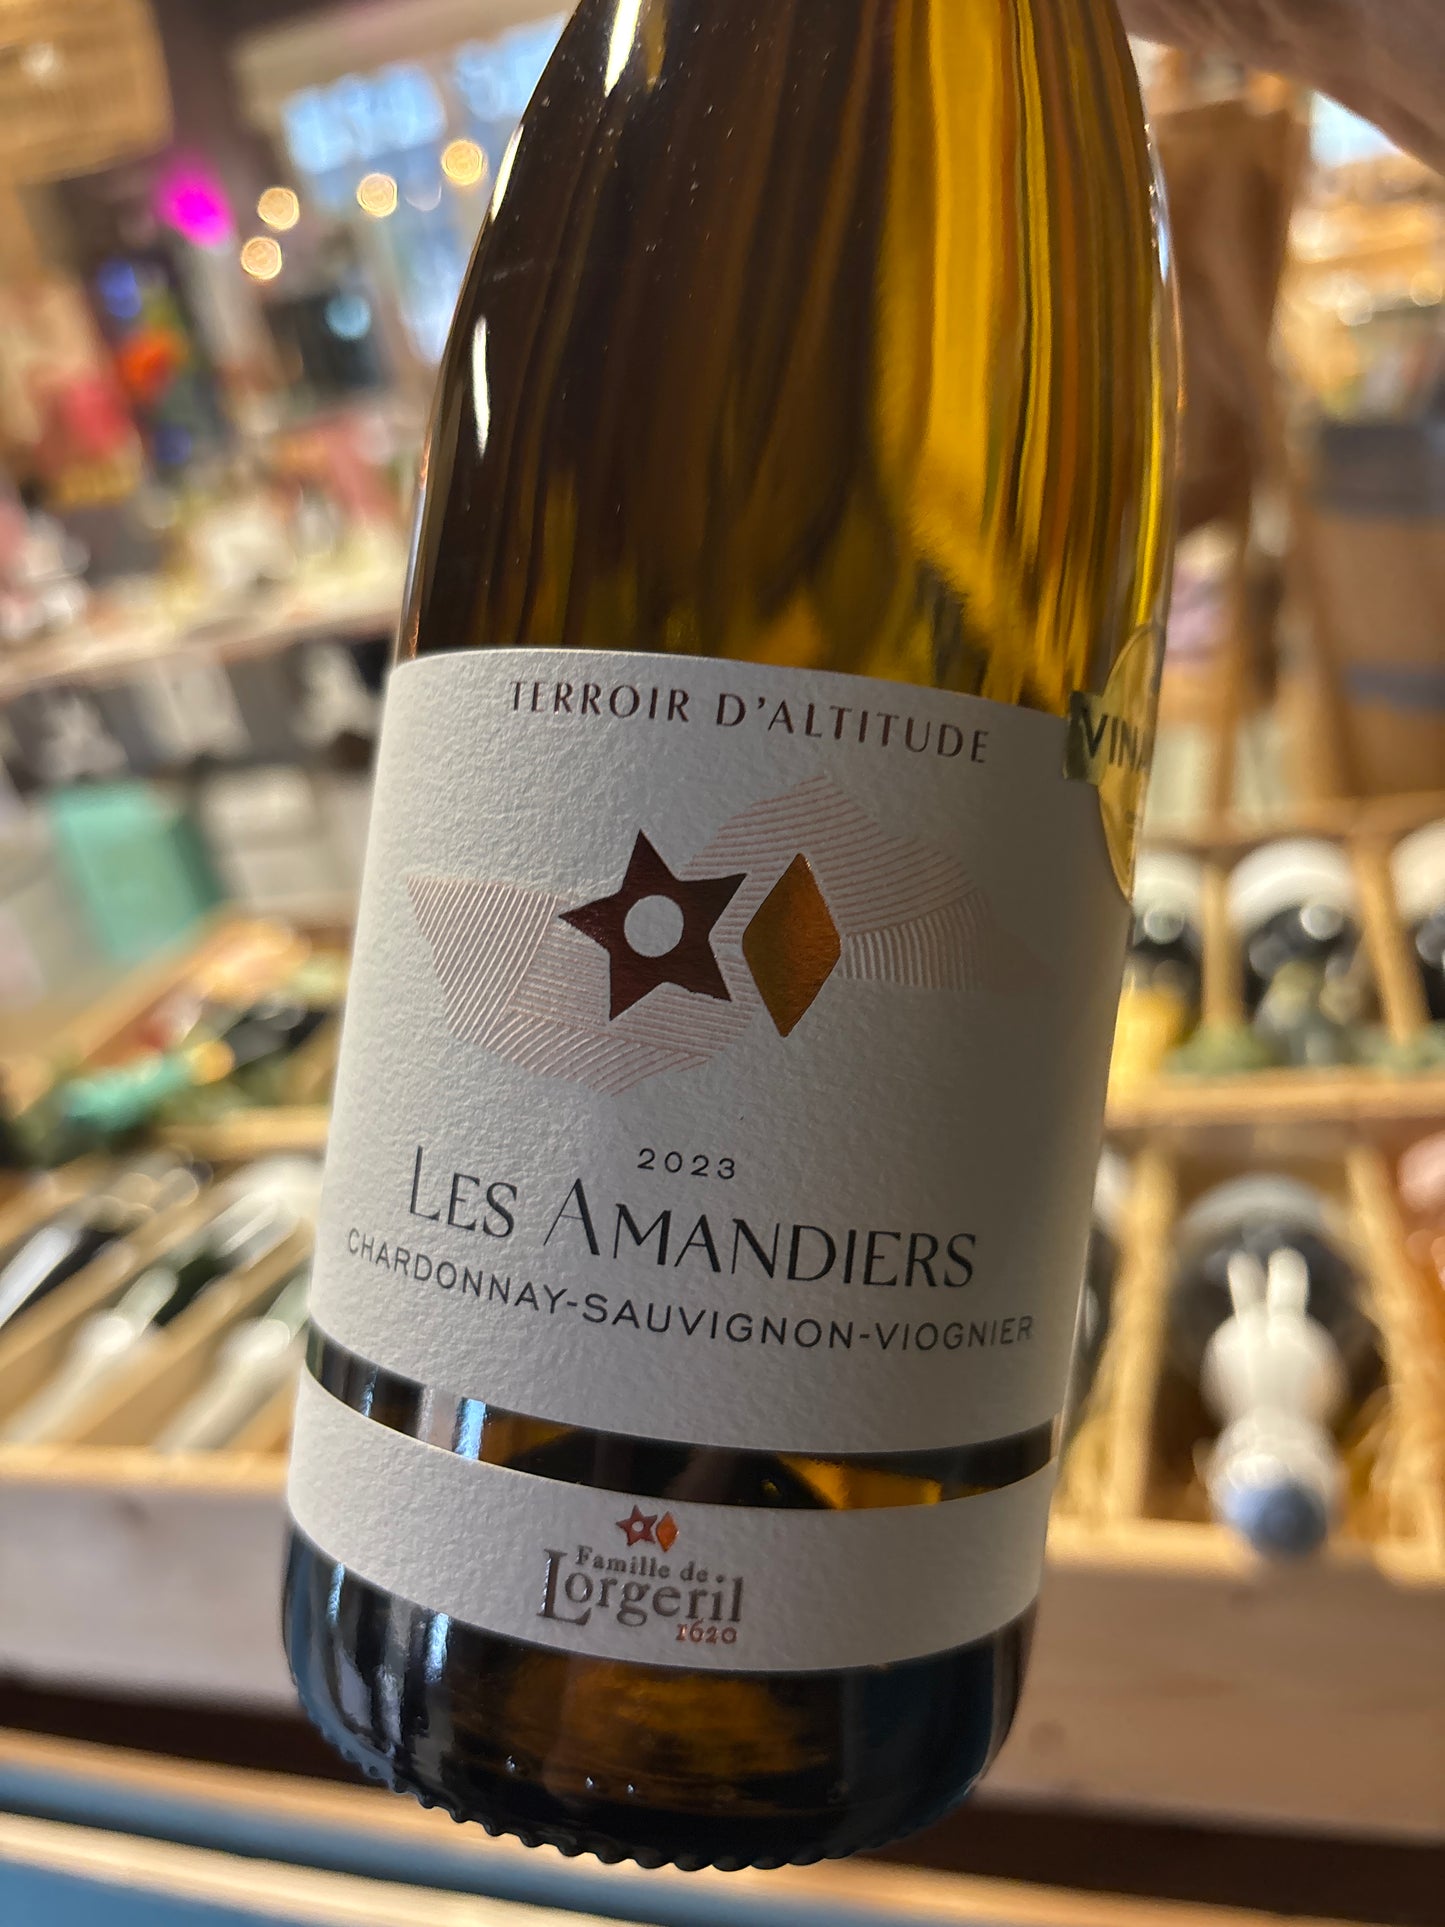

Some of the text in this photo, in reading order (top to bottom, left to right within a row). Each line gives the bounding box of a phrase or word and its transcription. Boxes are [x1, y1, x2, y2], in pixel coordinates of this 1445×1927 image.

[510, 681, 991, 763] TERROIR D’ALTITUDE
[637, 1148, 736, 1180] 2023
[410, 1145, 977, 1288] LES AMANDIERS
[348, 1227, 1034, 1351] CHARDONNAY-SAUVIGNON-VIOGNIER
[536, 1548, 744, 1627] Lorgeril
[575, 1544, 709, 1583] Famille de
[675, 1619, 738, 1645] 1620
